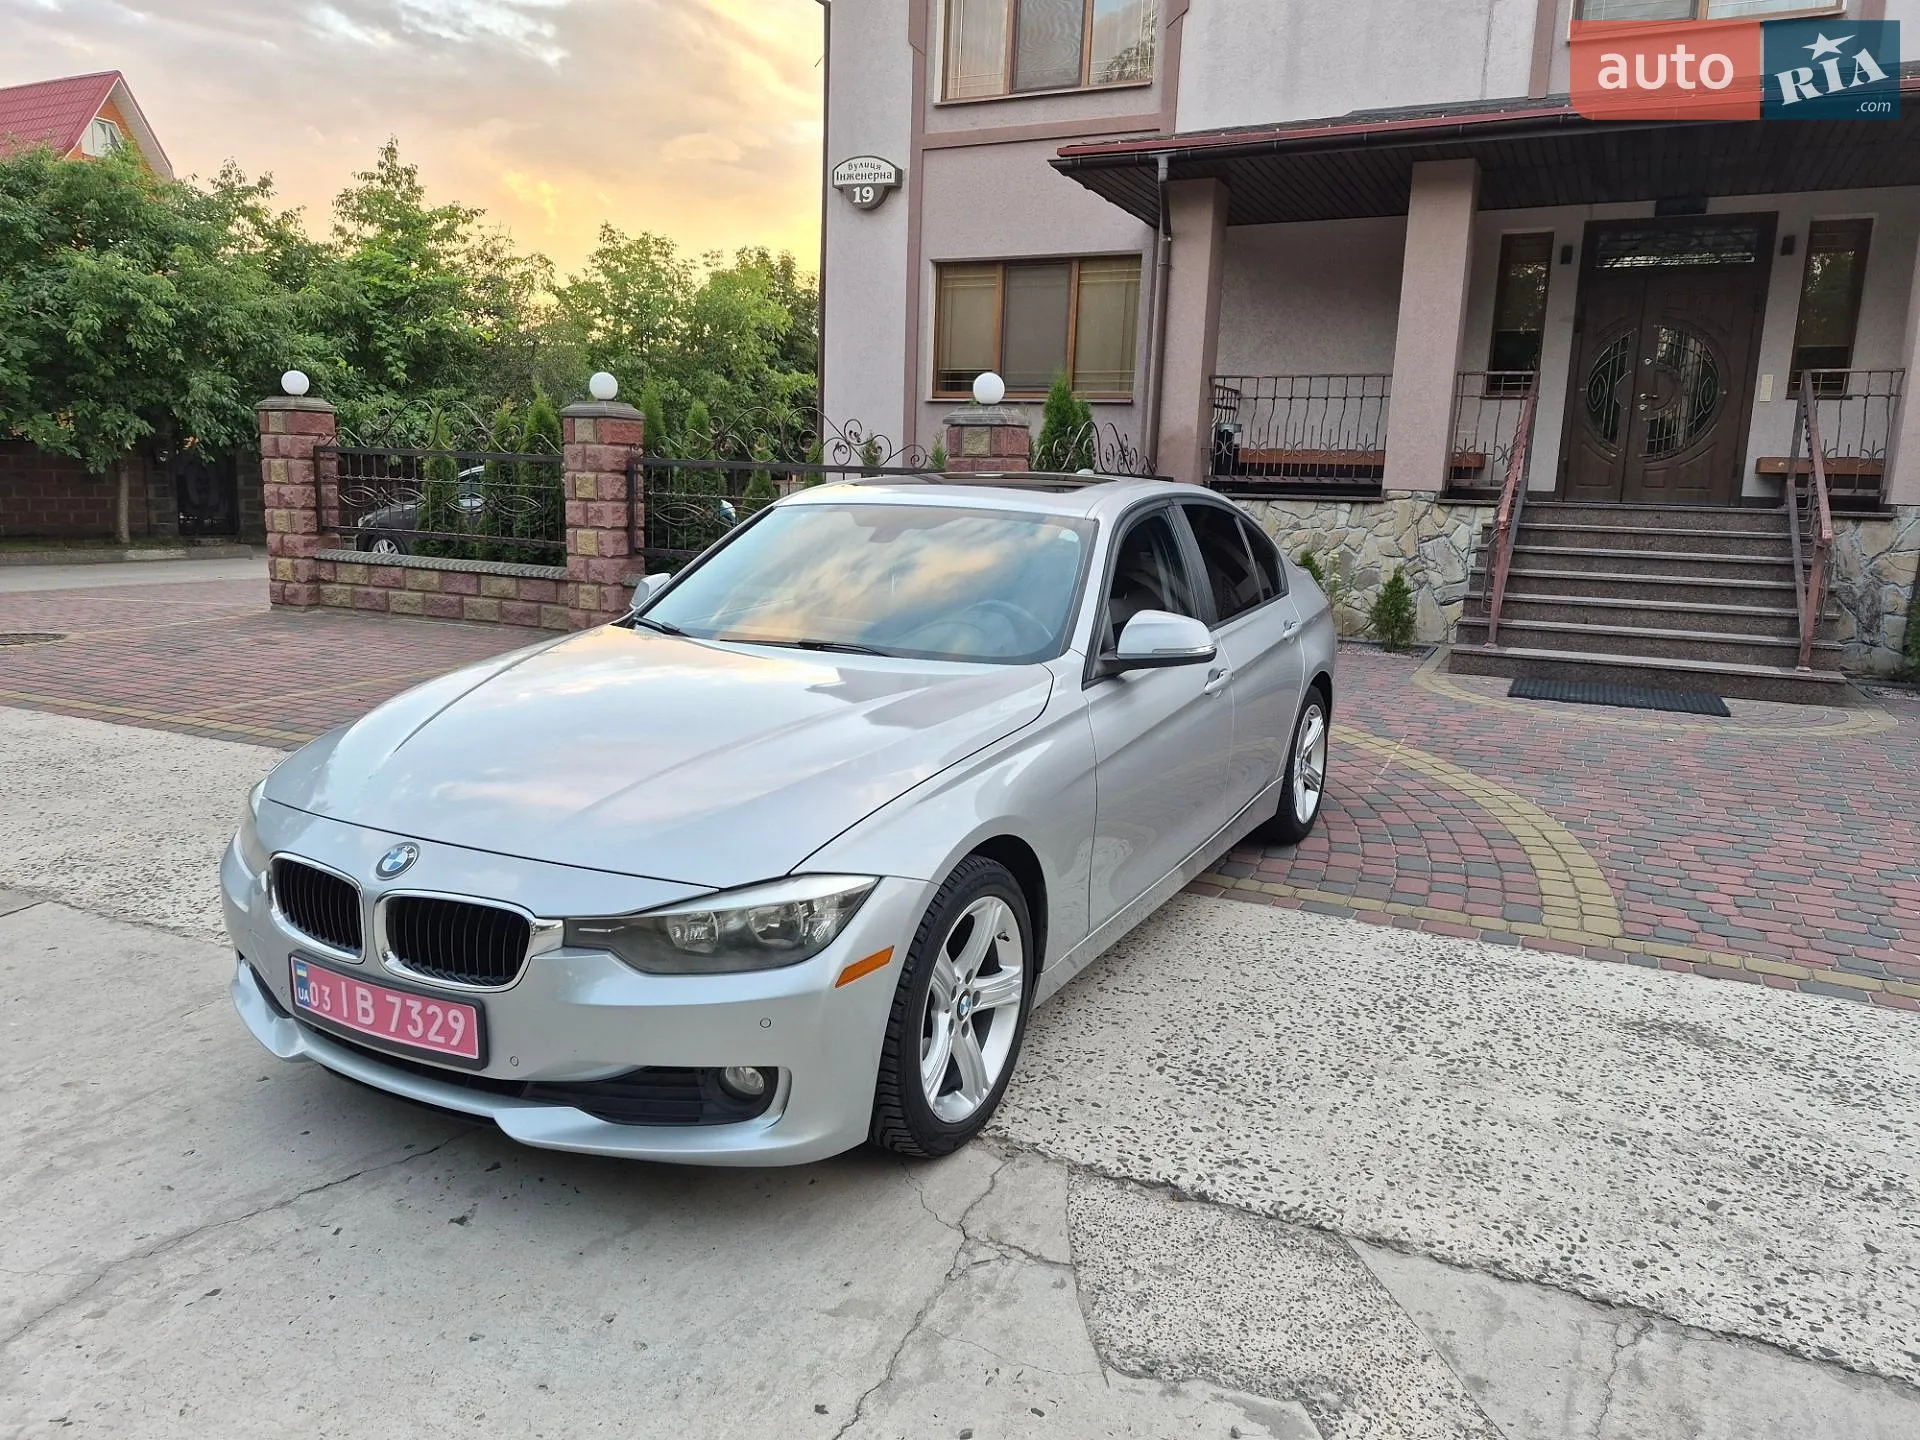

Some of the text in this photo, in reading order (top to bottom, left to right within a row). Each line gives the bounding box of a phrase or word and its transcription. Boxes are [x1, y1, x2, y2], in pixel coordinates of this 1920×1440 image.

[836, 171, 893, 182] Інженерна
[852, 186, 875, 203] 19
[298, 987, 310, 1003] UA
[309, 982, 331, 1012] 03
[385, 994, 466, 1046] 7329
